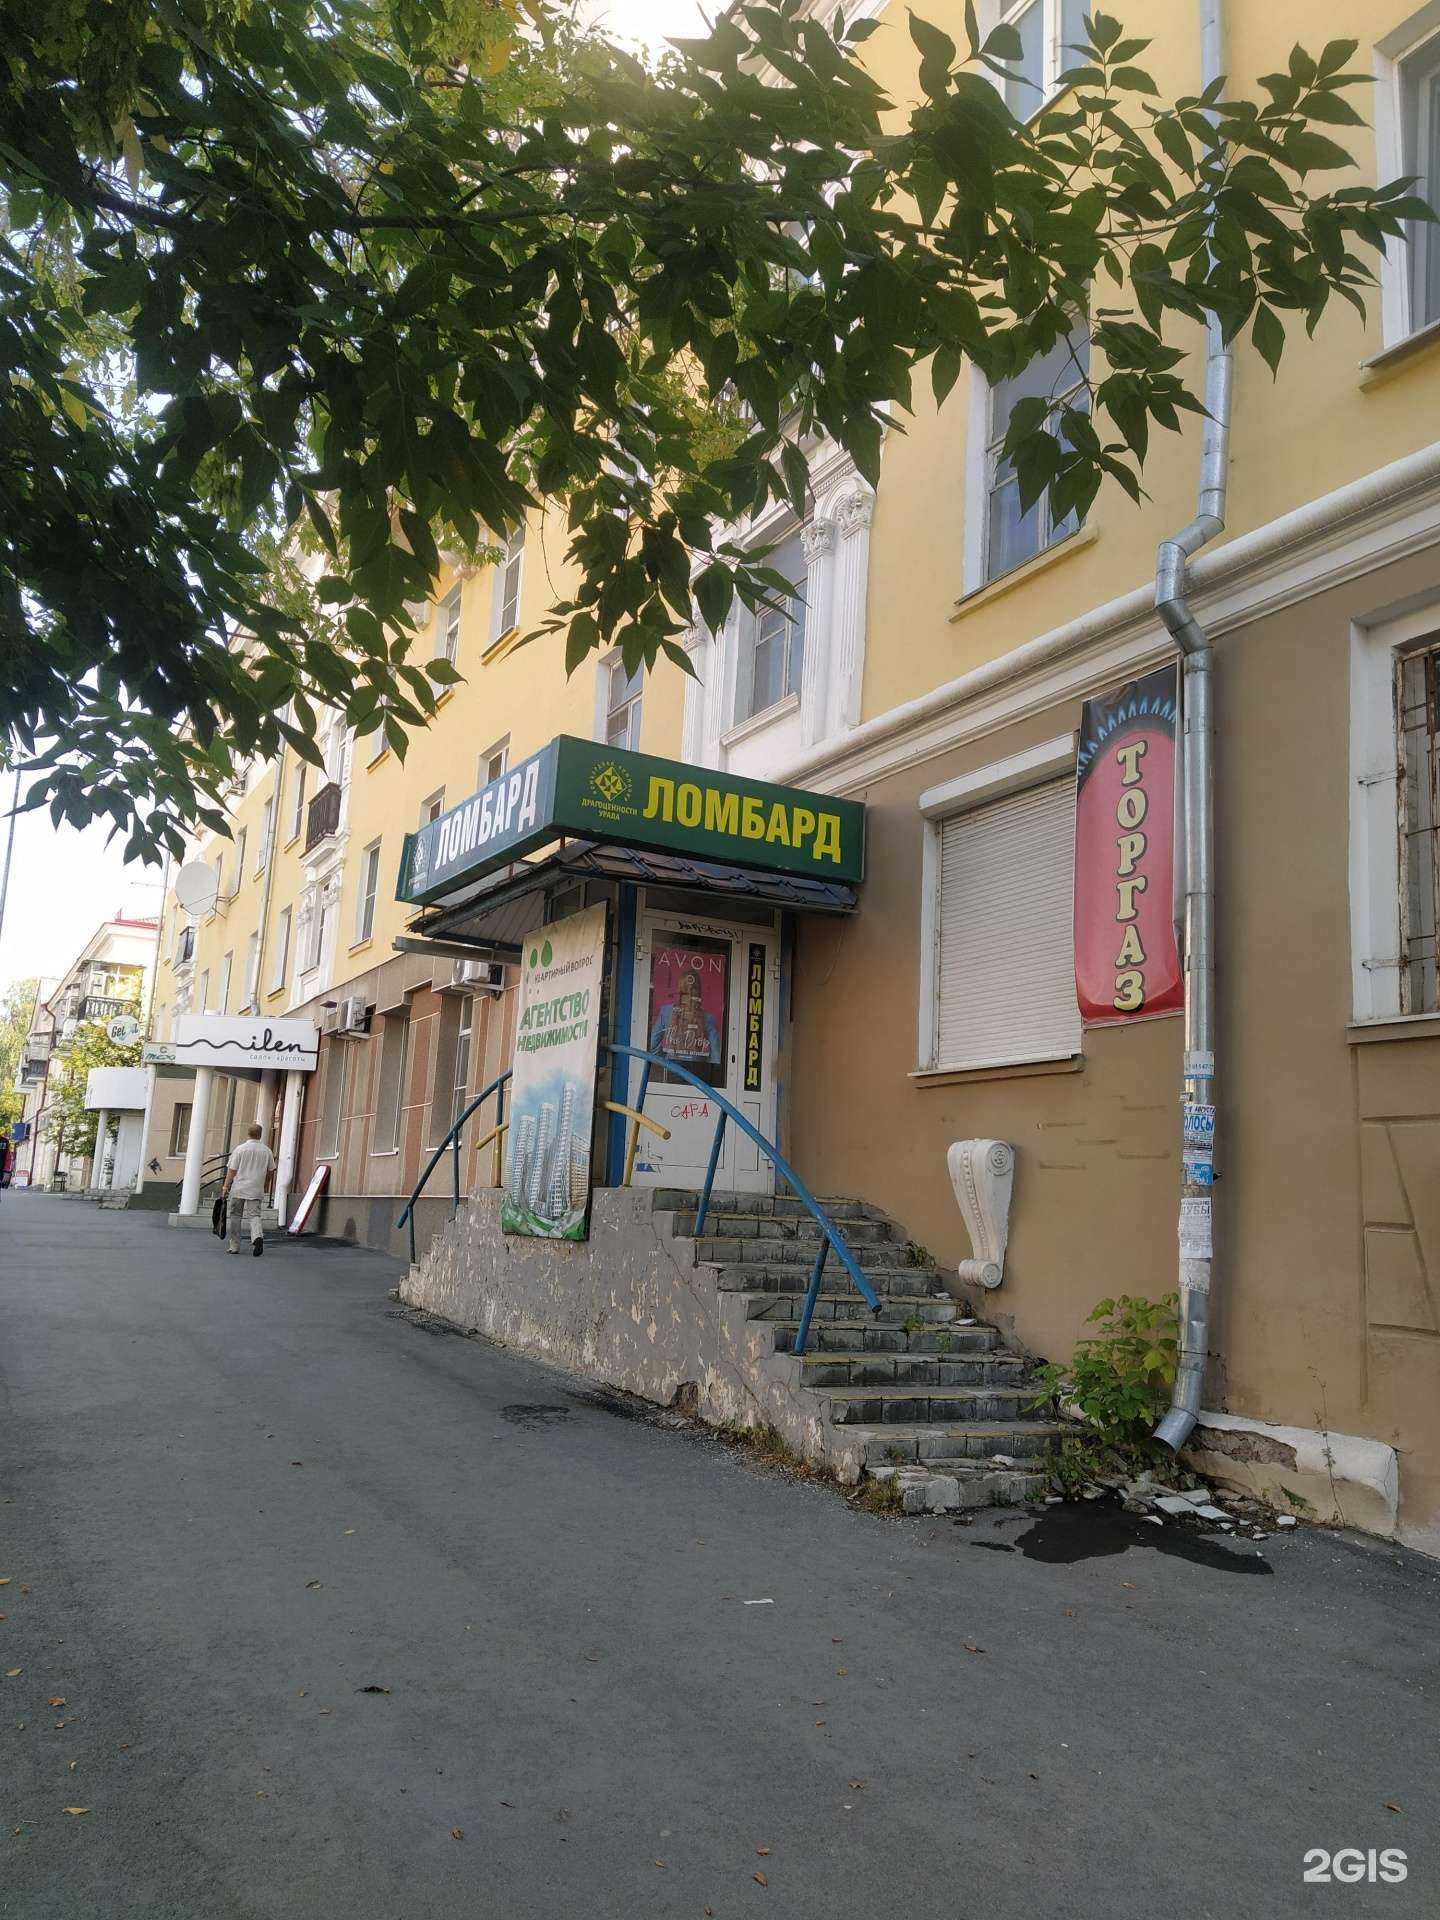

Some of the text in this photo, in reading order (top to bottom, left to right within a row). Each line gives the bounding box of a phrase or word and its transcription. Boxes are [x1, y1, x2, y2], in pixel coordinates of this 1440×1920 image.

[434, 759, 540, 870] ЛОМБАРД
[581, 798, 638, 816] ДРАГОЦЕННОСТИ
[643, 776, 841, 864] ЛОМБАРД
[1114, 741, 1147, 1011] ТОРГАЗ
[658, 951, 722, 973] AVON
[517, 1020, 588, 1054] НЕДВИЖИМОСТИ
[519, 988, 590, 1030] АГЕНТСТВО
[746, 964, 762, 1086] ЛОМБАРД
